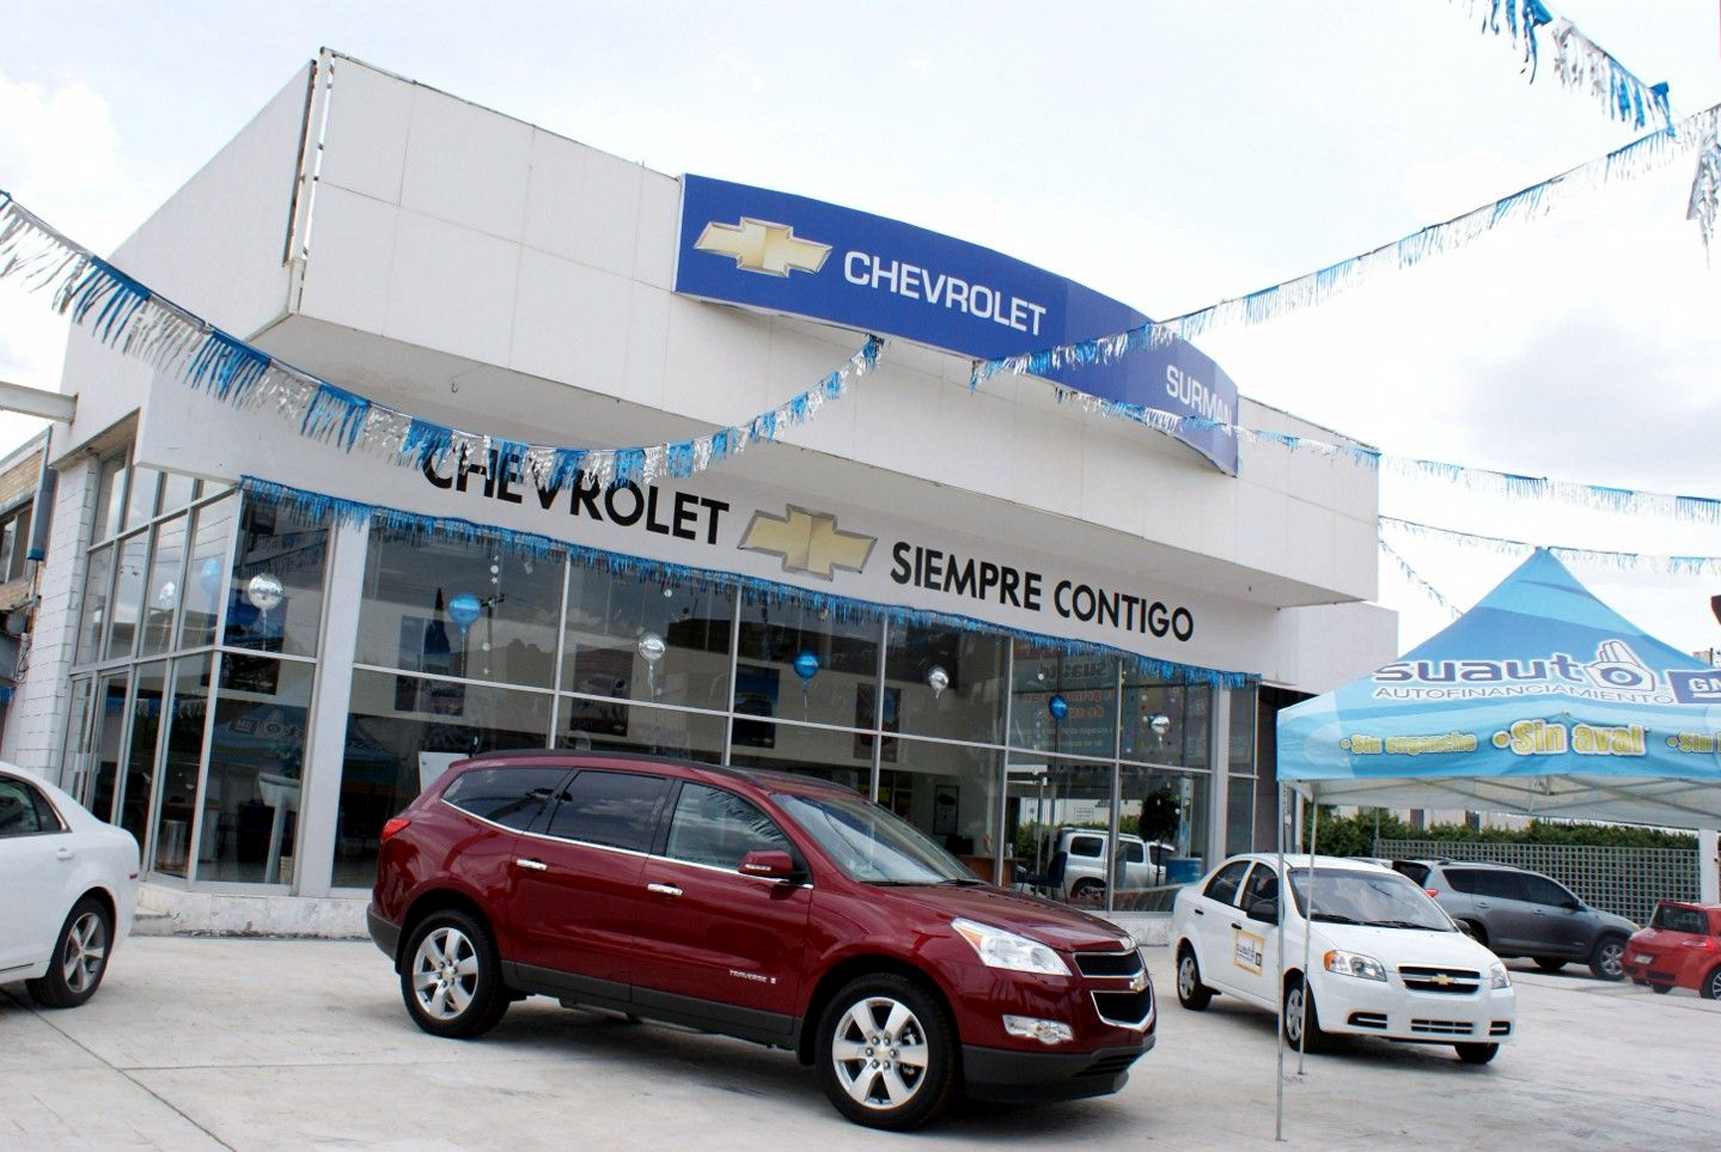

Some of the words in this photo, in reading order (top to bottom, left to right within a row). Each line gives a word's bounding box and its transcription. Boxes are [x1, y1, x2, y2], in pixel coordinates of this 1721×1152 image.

[844, 250, 1047, 336] CHEVROLET
[422, 439, 730, 545] CHEVROLET
[890, 541, 1042, 611] SIEMPRE
[1054, 581, 1195, 642] CONTIGO
[1375, 683, 1674, 704] AUTOFINANCIAMIENTO
[1511, 720, 1567, 755] Sin
[1573, 724, 1646, 755] aval
